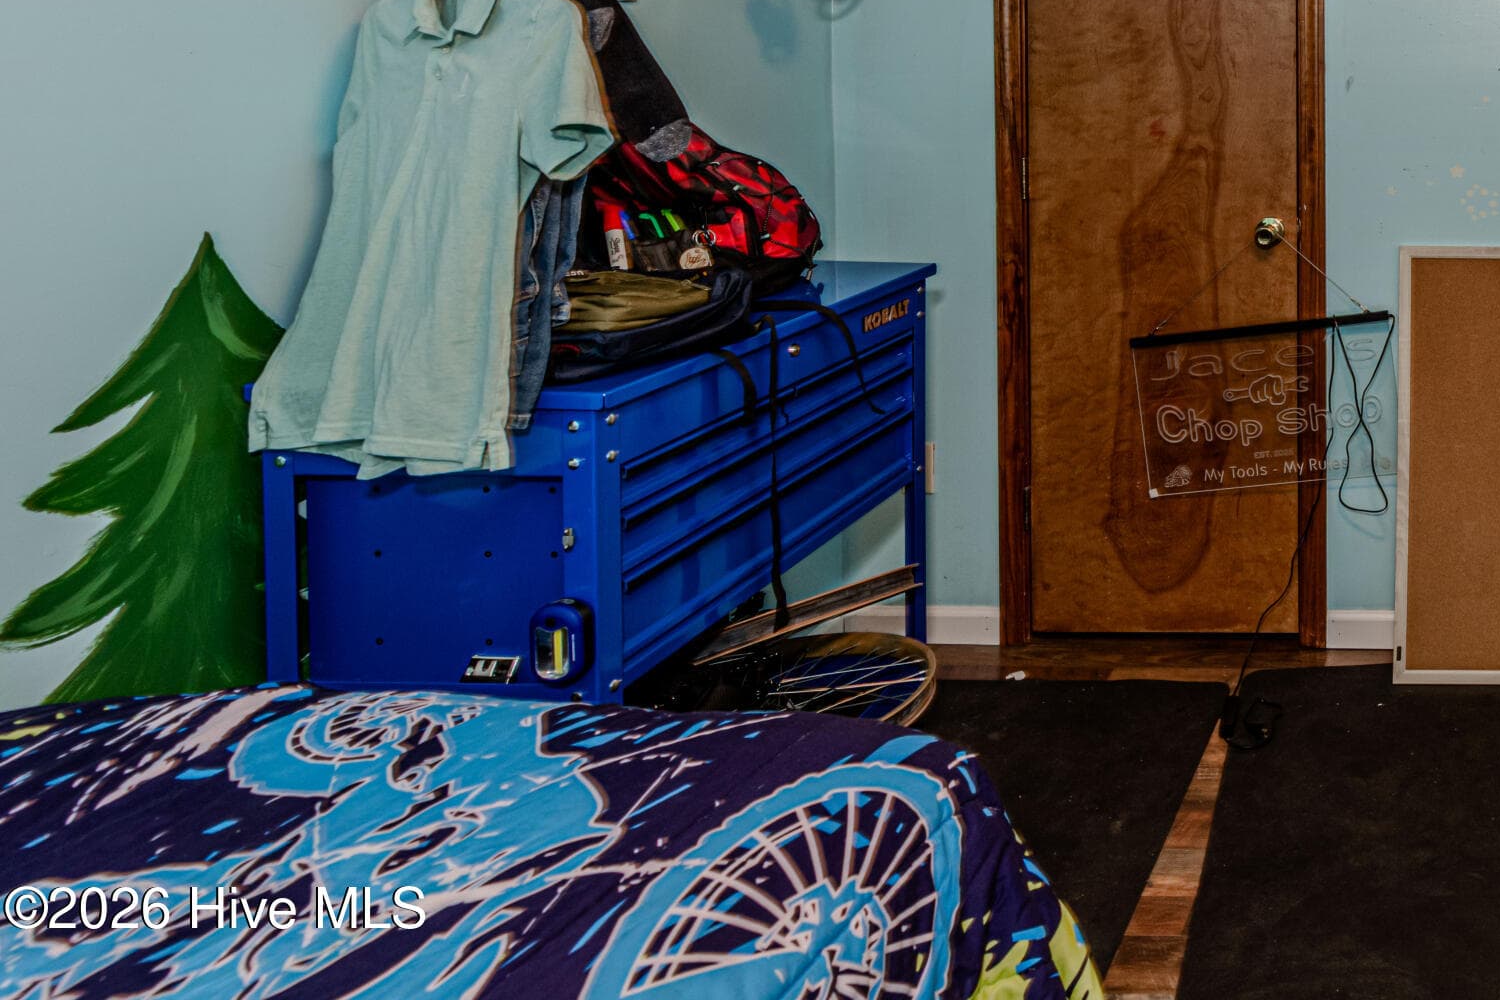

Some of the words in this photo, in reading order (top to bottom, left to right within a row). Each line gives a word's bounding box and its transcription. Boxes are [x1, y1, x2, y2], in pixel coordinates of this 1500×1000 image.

[864, 299, 910, 333] KOBALT
[1156, 404, 1263, 447] Chop
[1276, 395, 1382, 435] Shop
[1204, 468, 1225, 482] My
[1229, 463, 1268, 479] Tools
[1283, 459, 1304, 476] My
[1308, 457, 1348, 472] Rues
